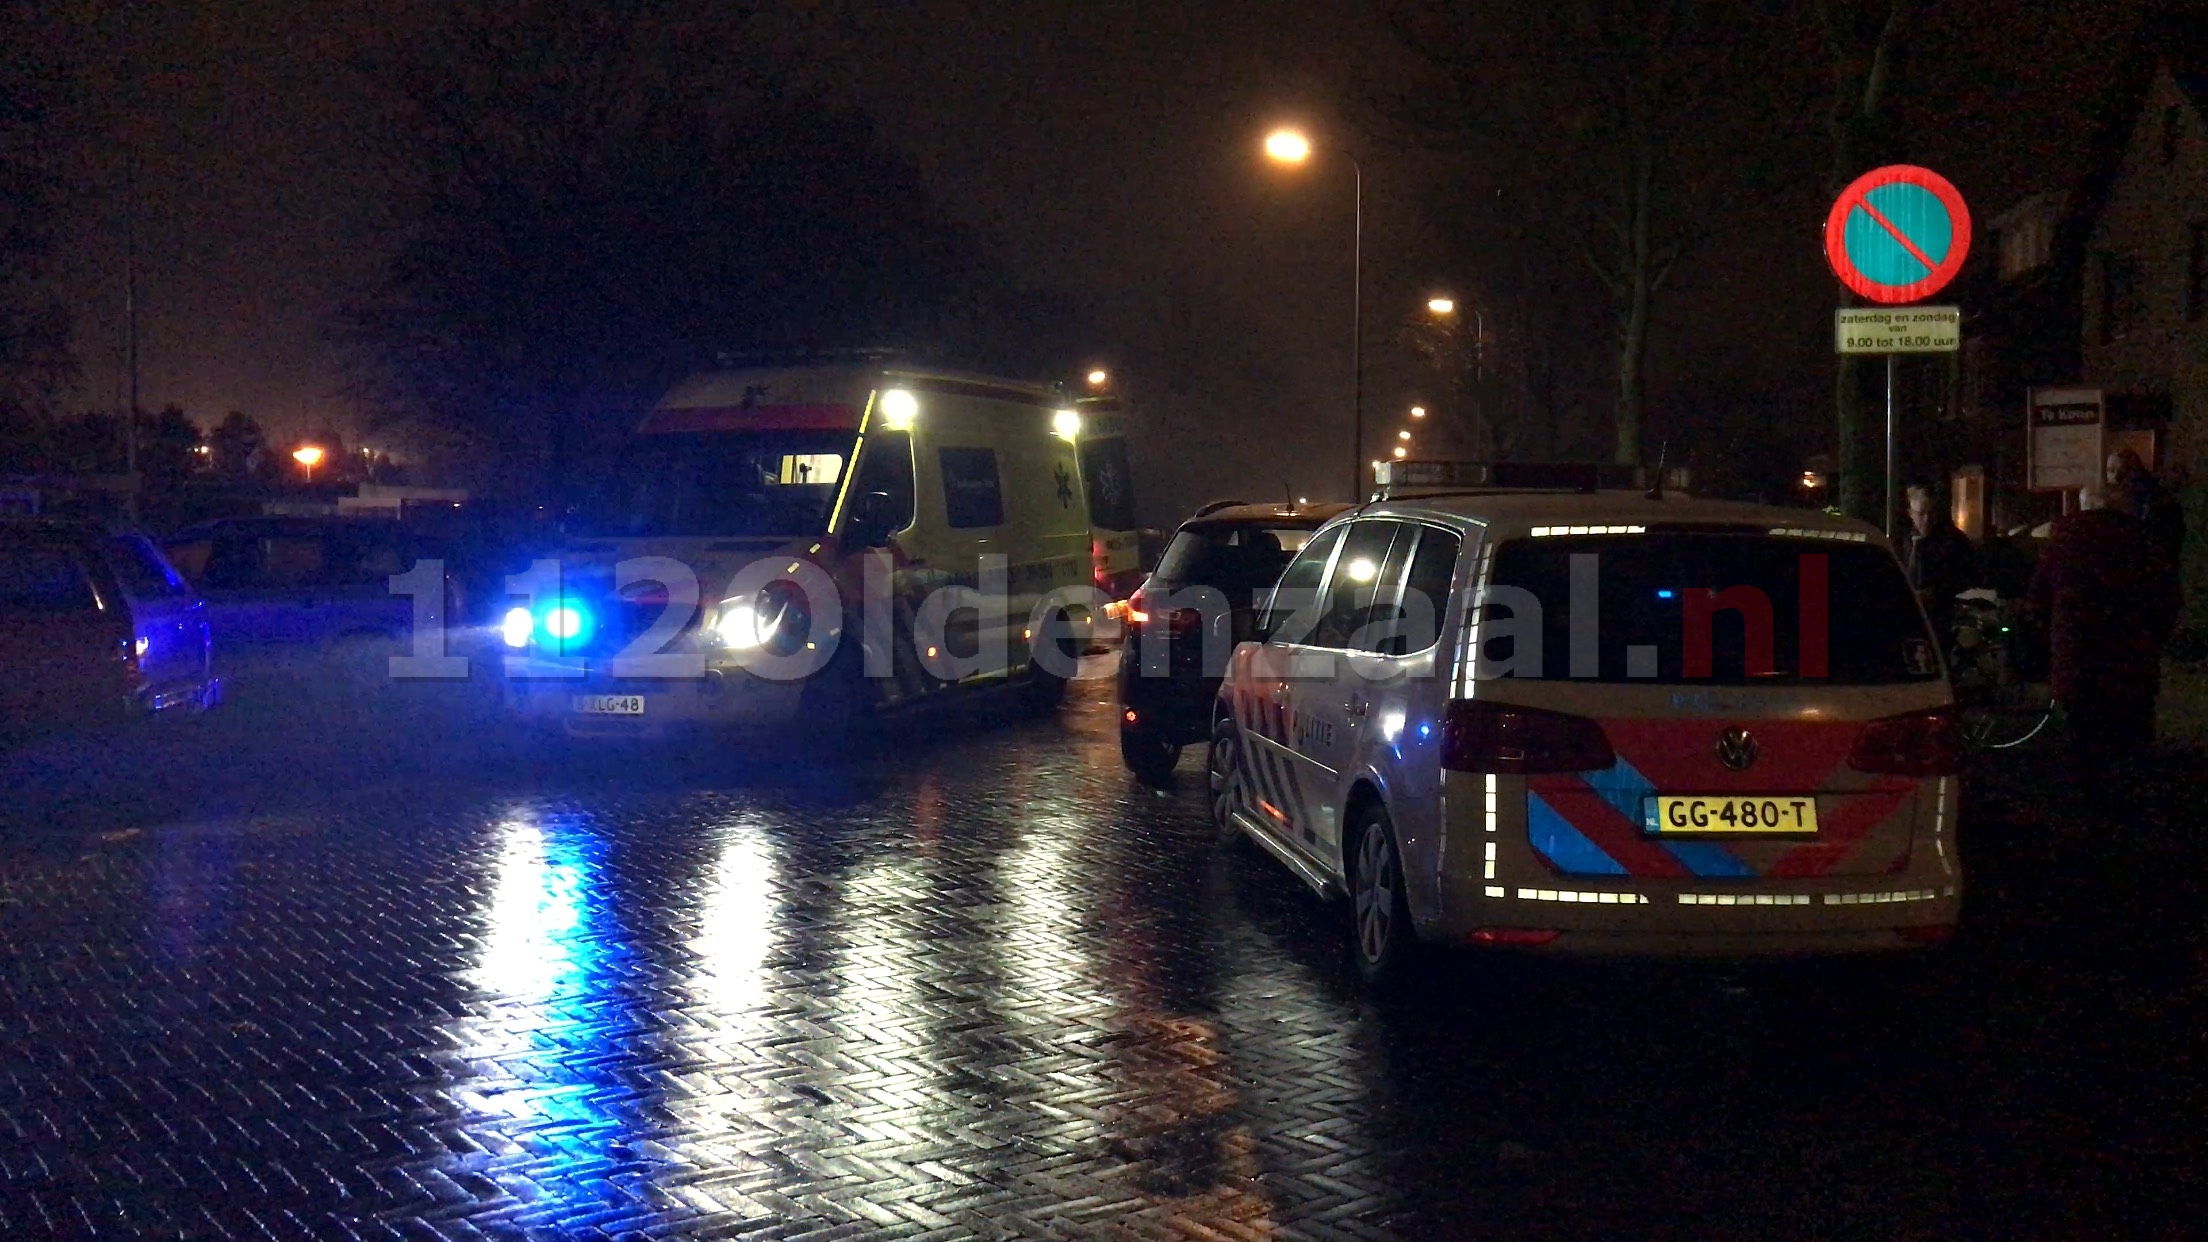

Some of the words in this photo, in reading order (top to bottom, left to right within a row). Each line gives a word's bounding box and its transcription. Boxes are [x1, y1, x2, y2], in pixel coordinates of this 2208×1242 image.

[1841, 313, 1892, 325] zaterdag
[1895, 315, 1909, 323] en
[1912, 312, 1956, 324] zondag
[1888, 325, 1907, 333] van
[1847, 337, 1873, 348] 9.00
[1876, 337, 1894, 347] tot
[1899, 336, 1930, 347] 18.00
[1933, 338, 1955, 347] uur
[1291, 710, 1331, 748] POLITIE
[1668, 800, 1807, 828] GG-480-T
